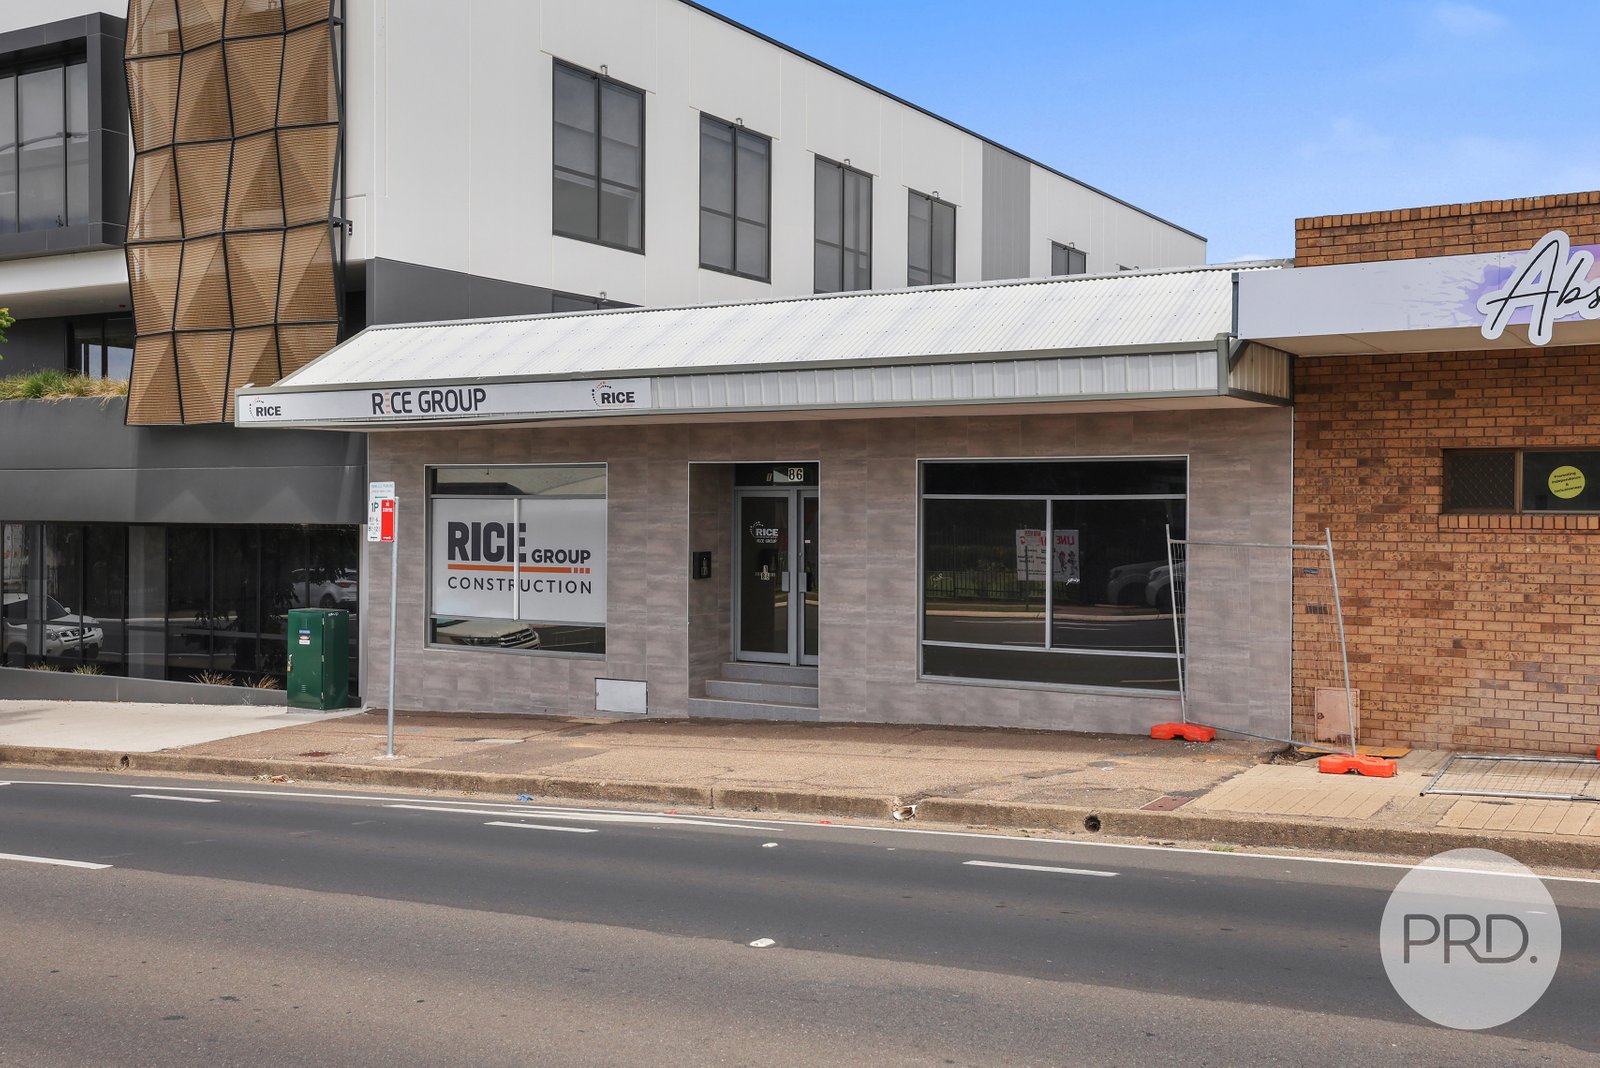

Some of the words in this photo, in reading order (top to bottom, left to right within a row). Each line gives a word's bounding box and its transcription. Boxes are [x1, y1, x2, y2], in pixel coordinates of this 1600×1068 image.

[371, 391, 413, 415] RICE
[418, 387, 487, 413] GROUP
[600, 391, 636, 404] RICE
[255, 405, 282, 417] RICE
[788, 468, 803, 480] 86
[371, 501, 379, 512] 1P
[755, 528, 779, 537] RICE
[447, 521, 527, 563] RICE
[531, 548, 591, 564] GROUP
[447, 576, 592, 594] CONSTRUCTION
